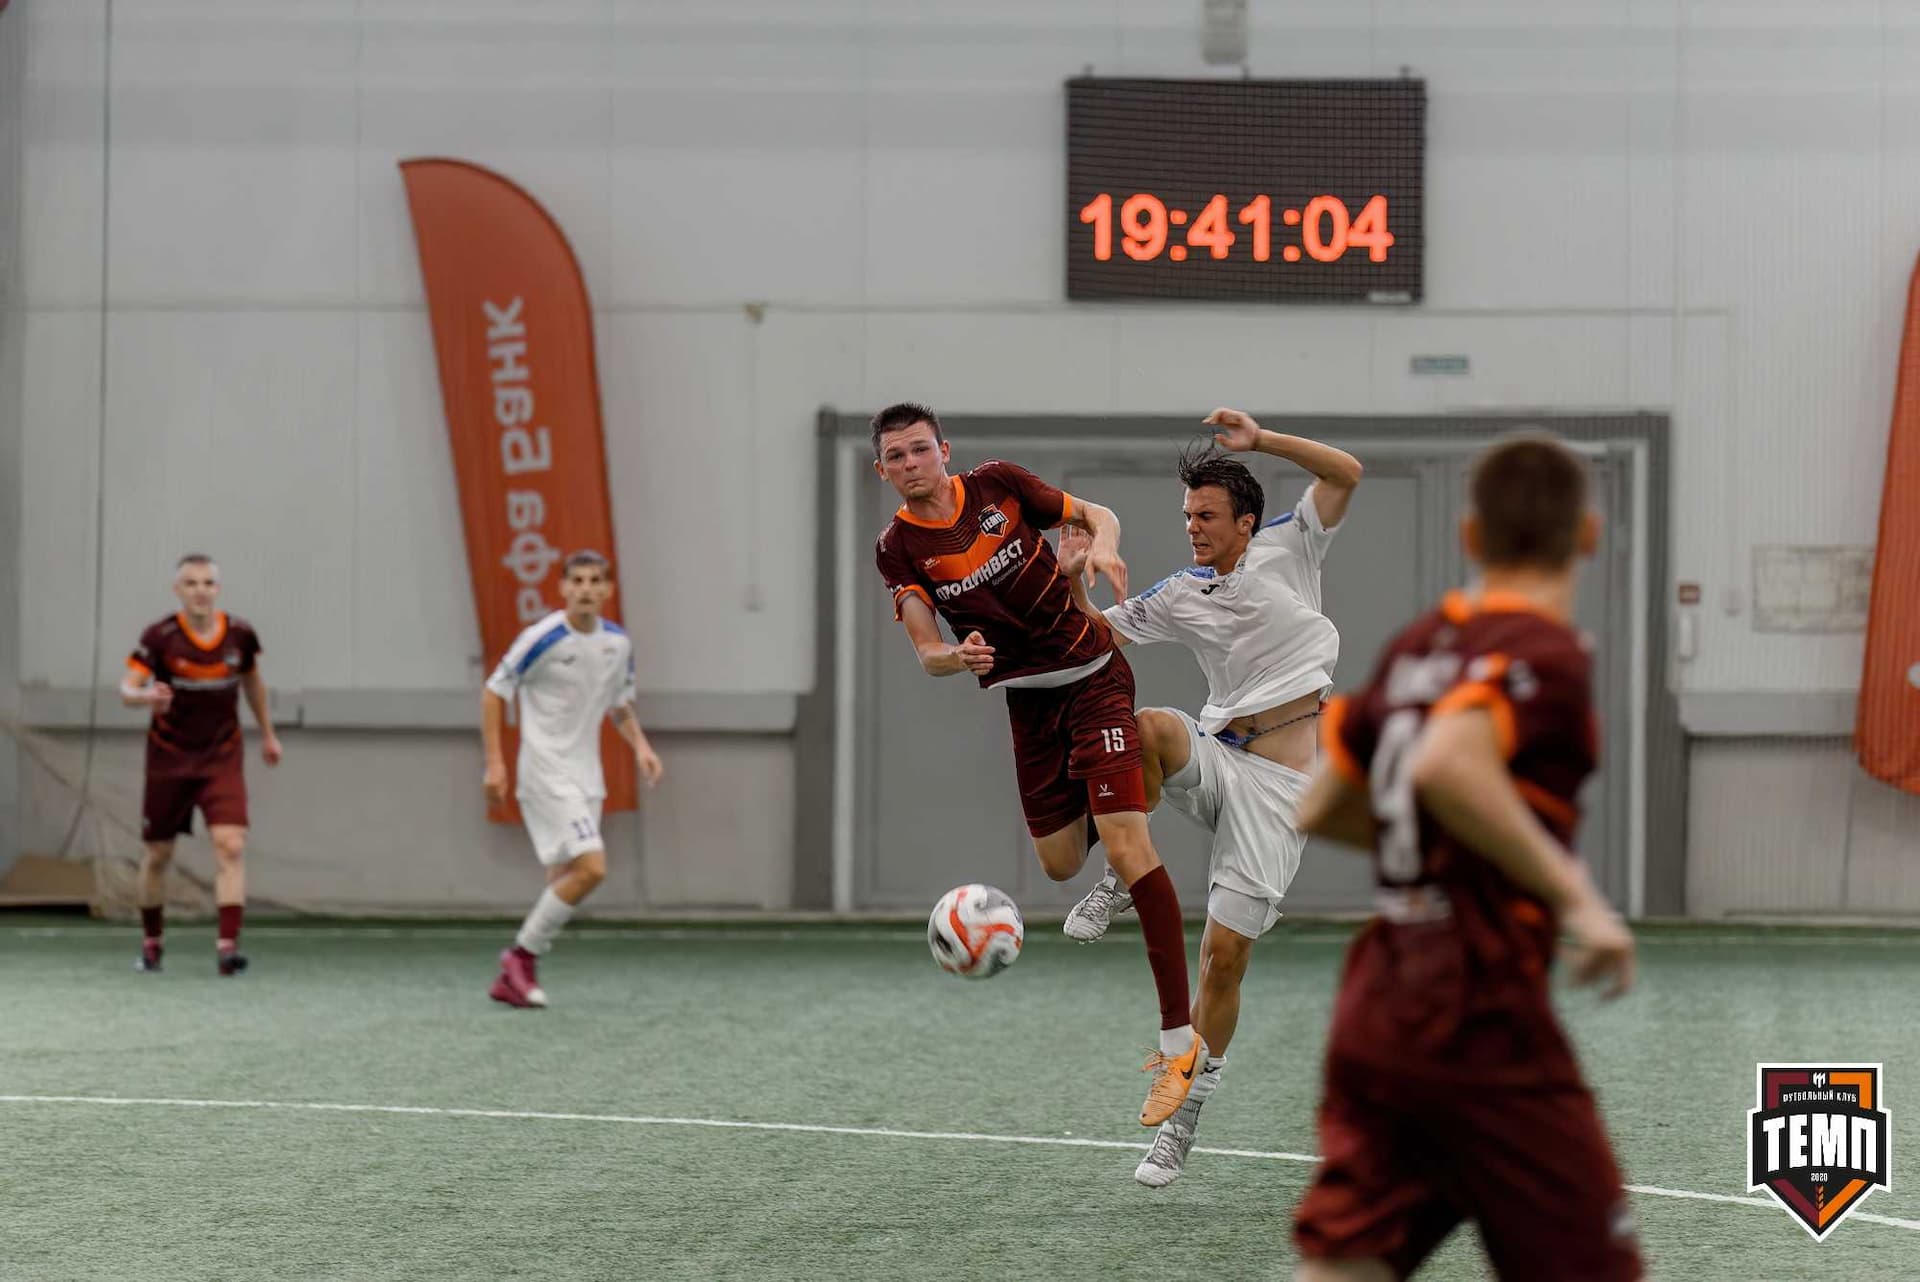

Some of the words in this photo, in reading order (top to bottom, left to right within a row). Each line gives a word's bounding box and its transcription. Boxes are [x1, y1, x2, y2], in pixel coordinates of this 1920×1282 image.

[1080, 192, 1395, 262] 19:41:04
[982, 513, 1005, 532] ТЕМП
[935, 538, 1024, 601] ПРОДИНВЕСТ
[1100, 727, 1126, 753] 15
